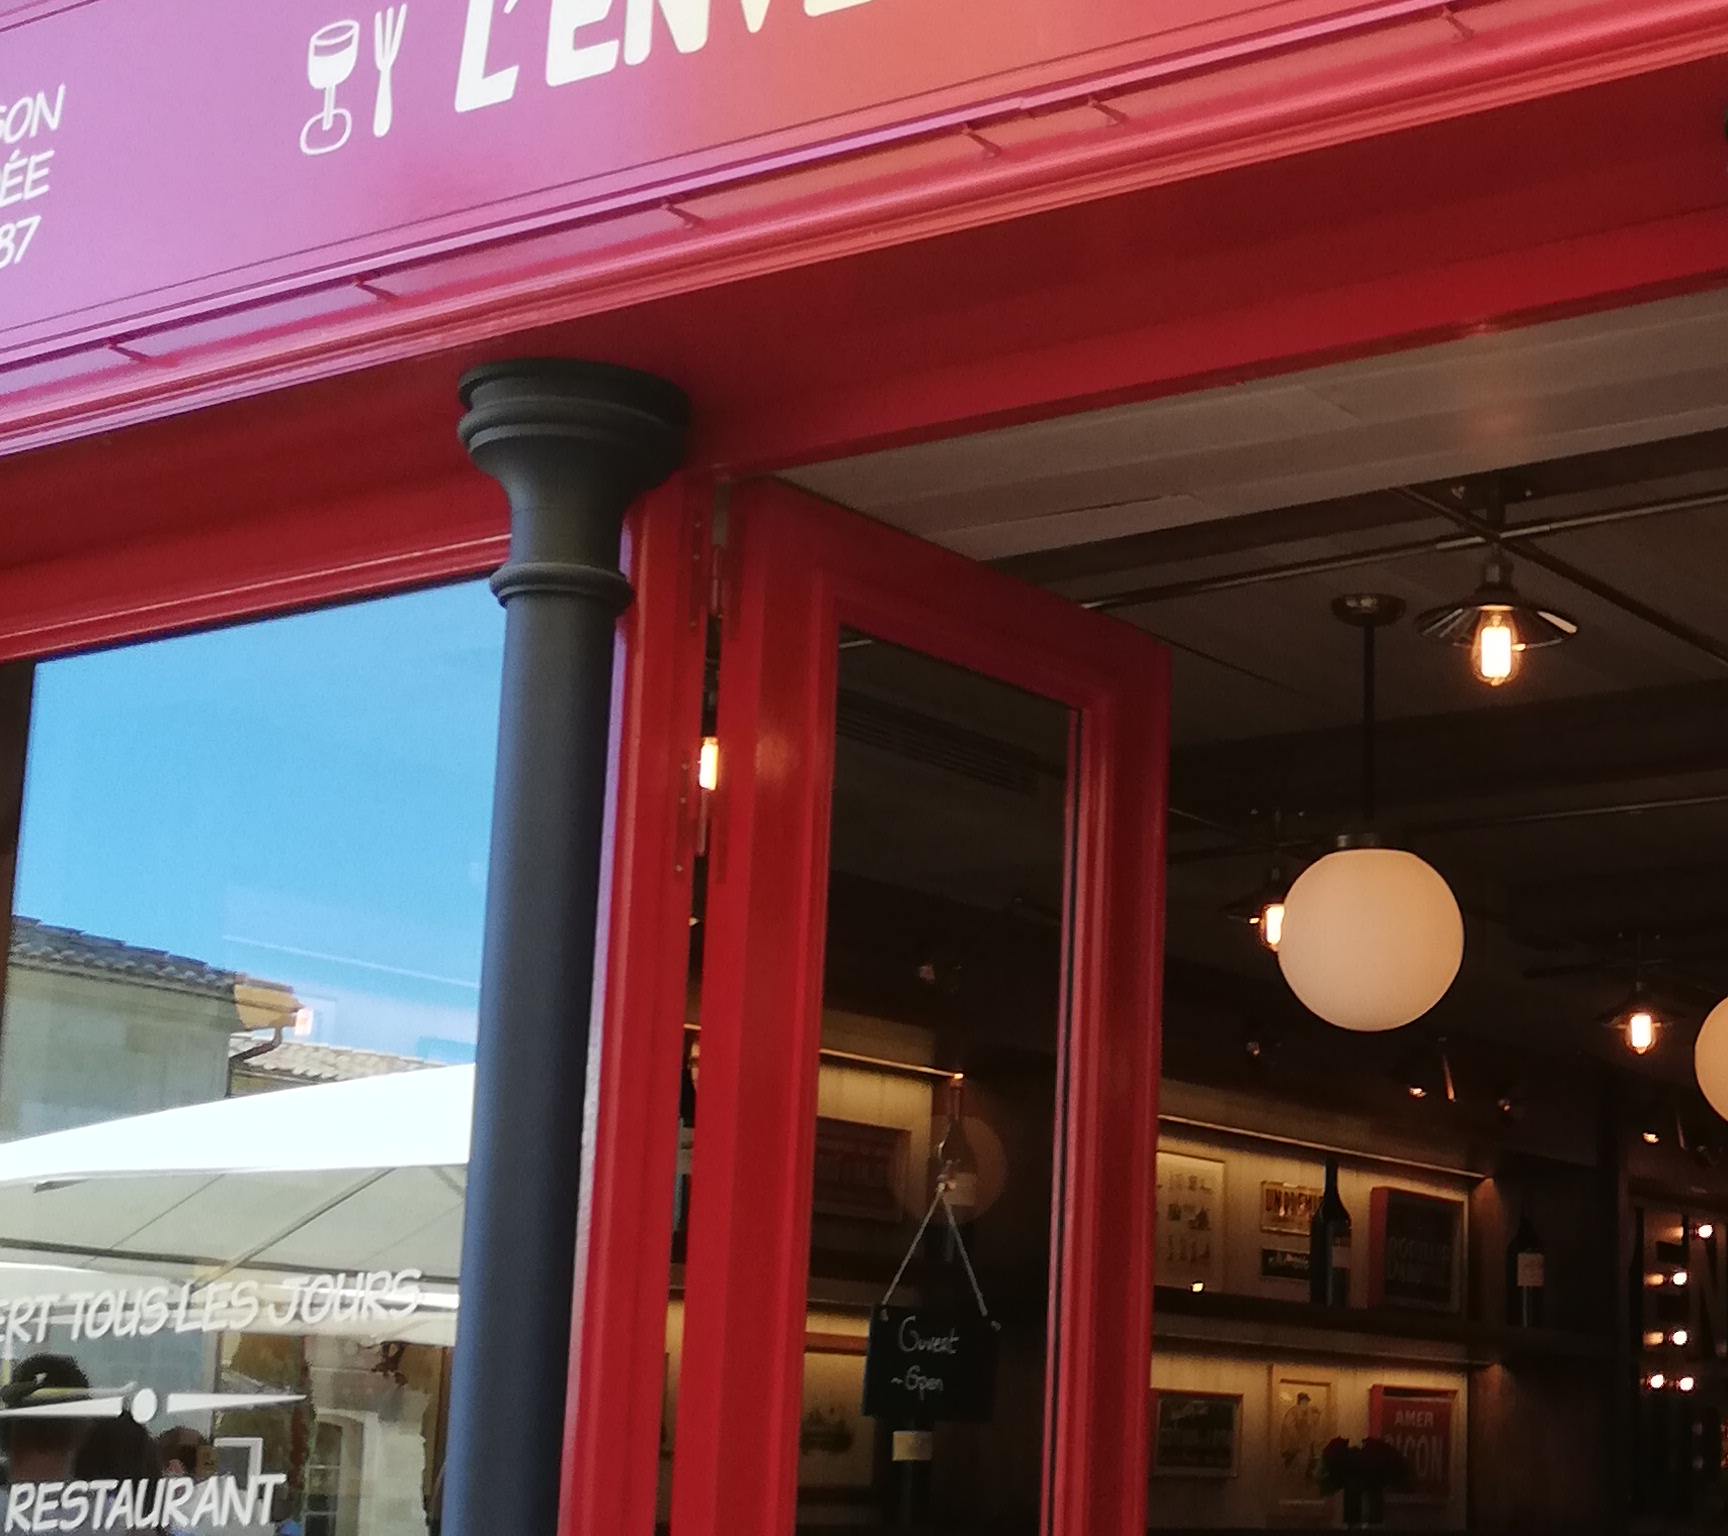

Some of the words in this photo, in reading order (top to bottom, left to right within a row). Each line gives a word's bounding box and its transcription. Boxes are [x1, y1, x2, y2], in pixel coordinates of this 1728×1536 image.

[65, 1285, 169, 1340] TOUS
[174, 1278, 260, 1333] LES
[266, 1268, 422, 1327] JOURS
[4, 1473, 287, 1534] RESTAURANT
